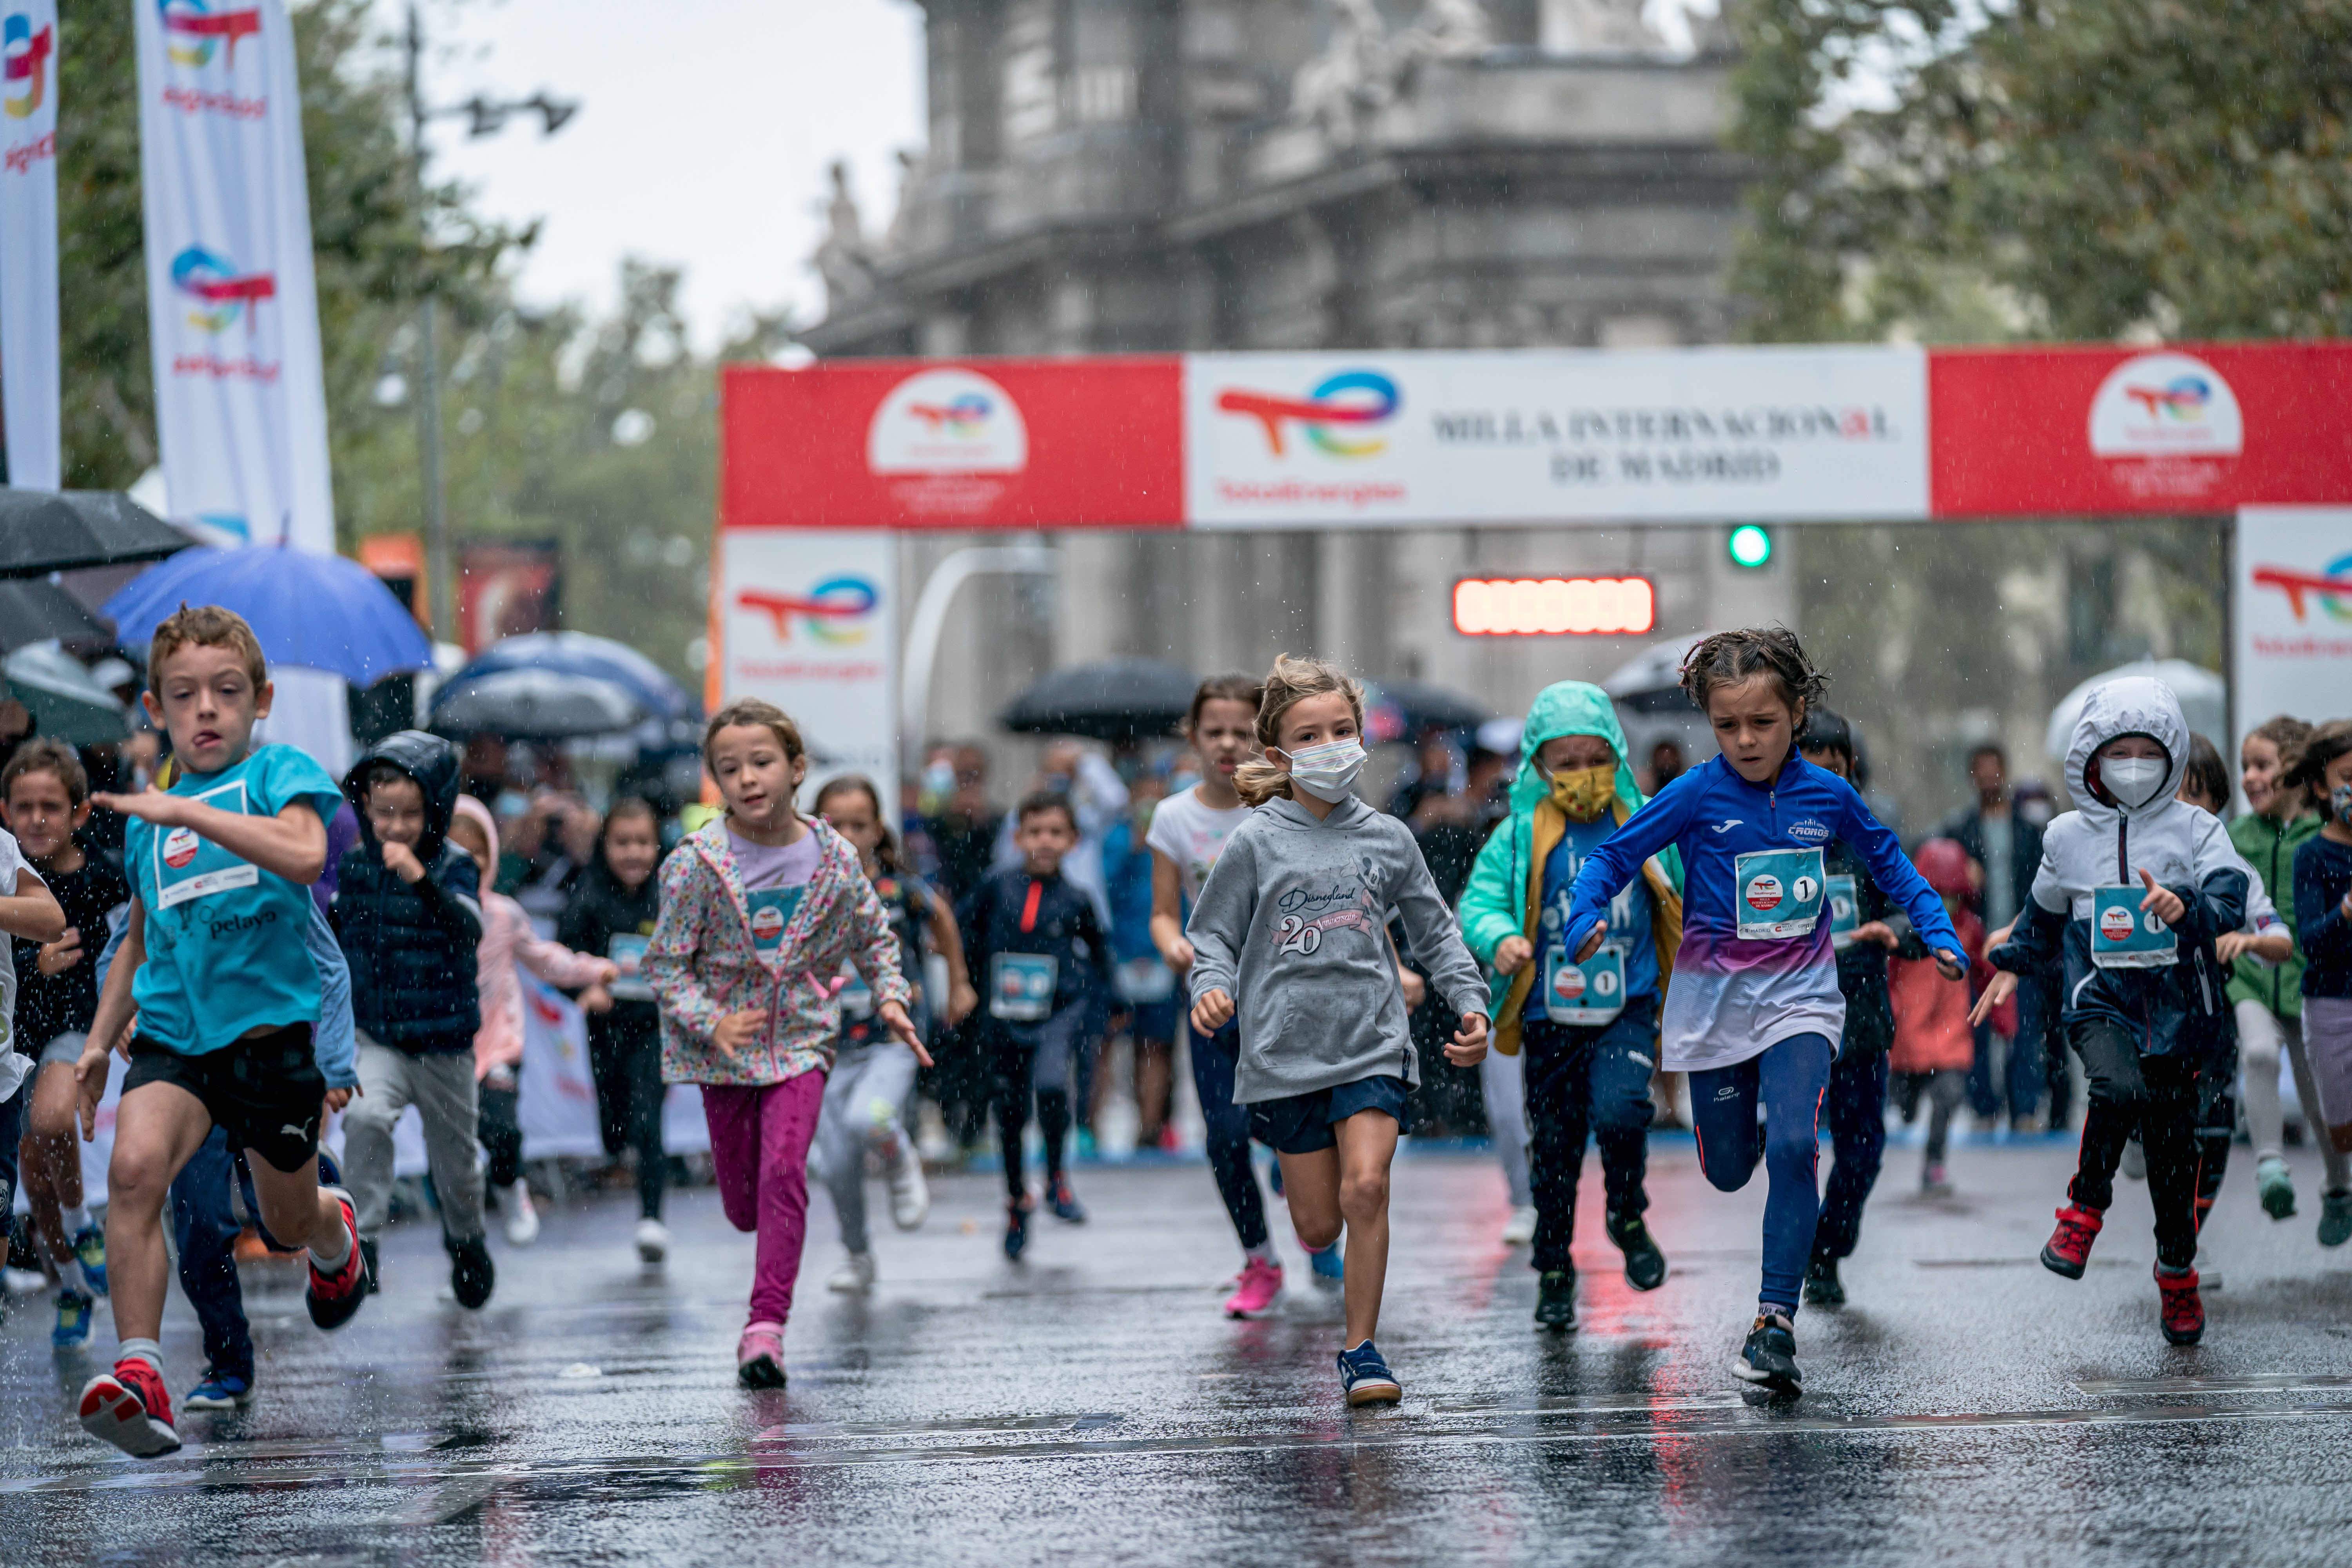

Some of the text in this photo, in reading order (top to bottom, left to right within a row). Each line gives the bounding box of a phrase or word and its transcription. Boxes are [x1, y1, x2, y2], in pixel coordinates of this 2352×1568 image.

[1549, 447, 1782, 482] DE MADRID
[1788, 826, 1829, 838] CRONOS
[1279, 885, 1356, 914] Disneyland
[1800, 880, 1808, 898] 1
[210, 911, 276, 940] pelayo
[1279, 914, 1322, 956] 20
[1602, 974, 1609, 991] 1
